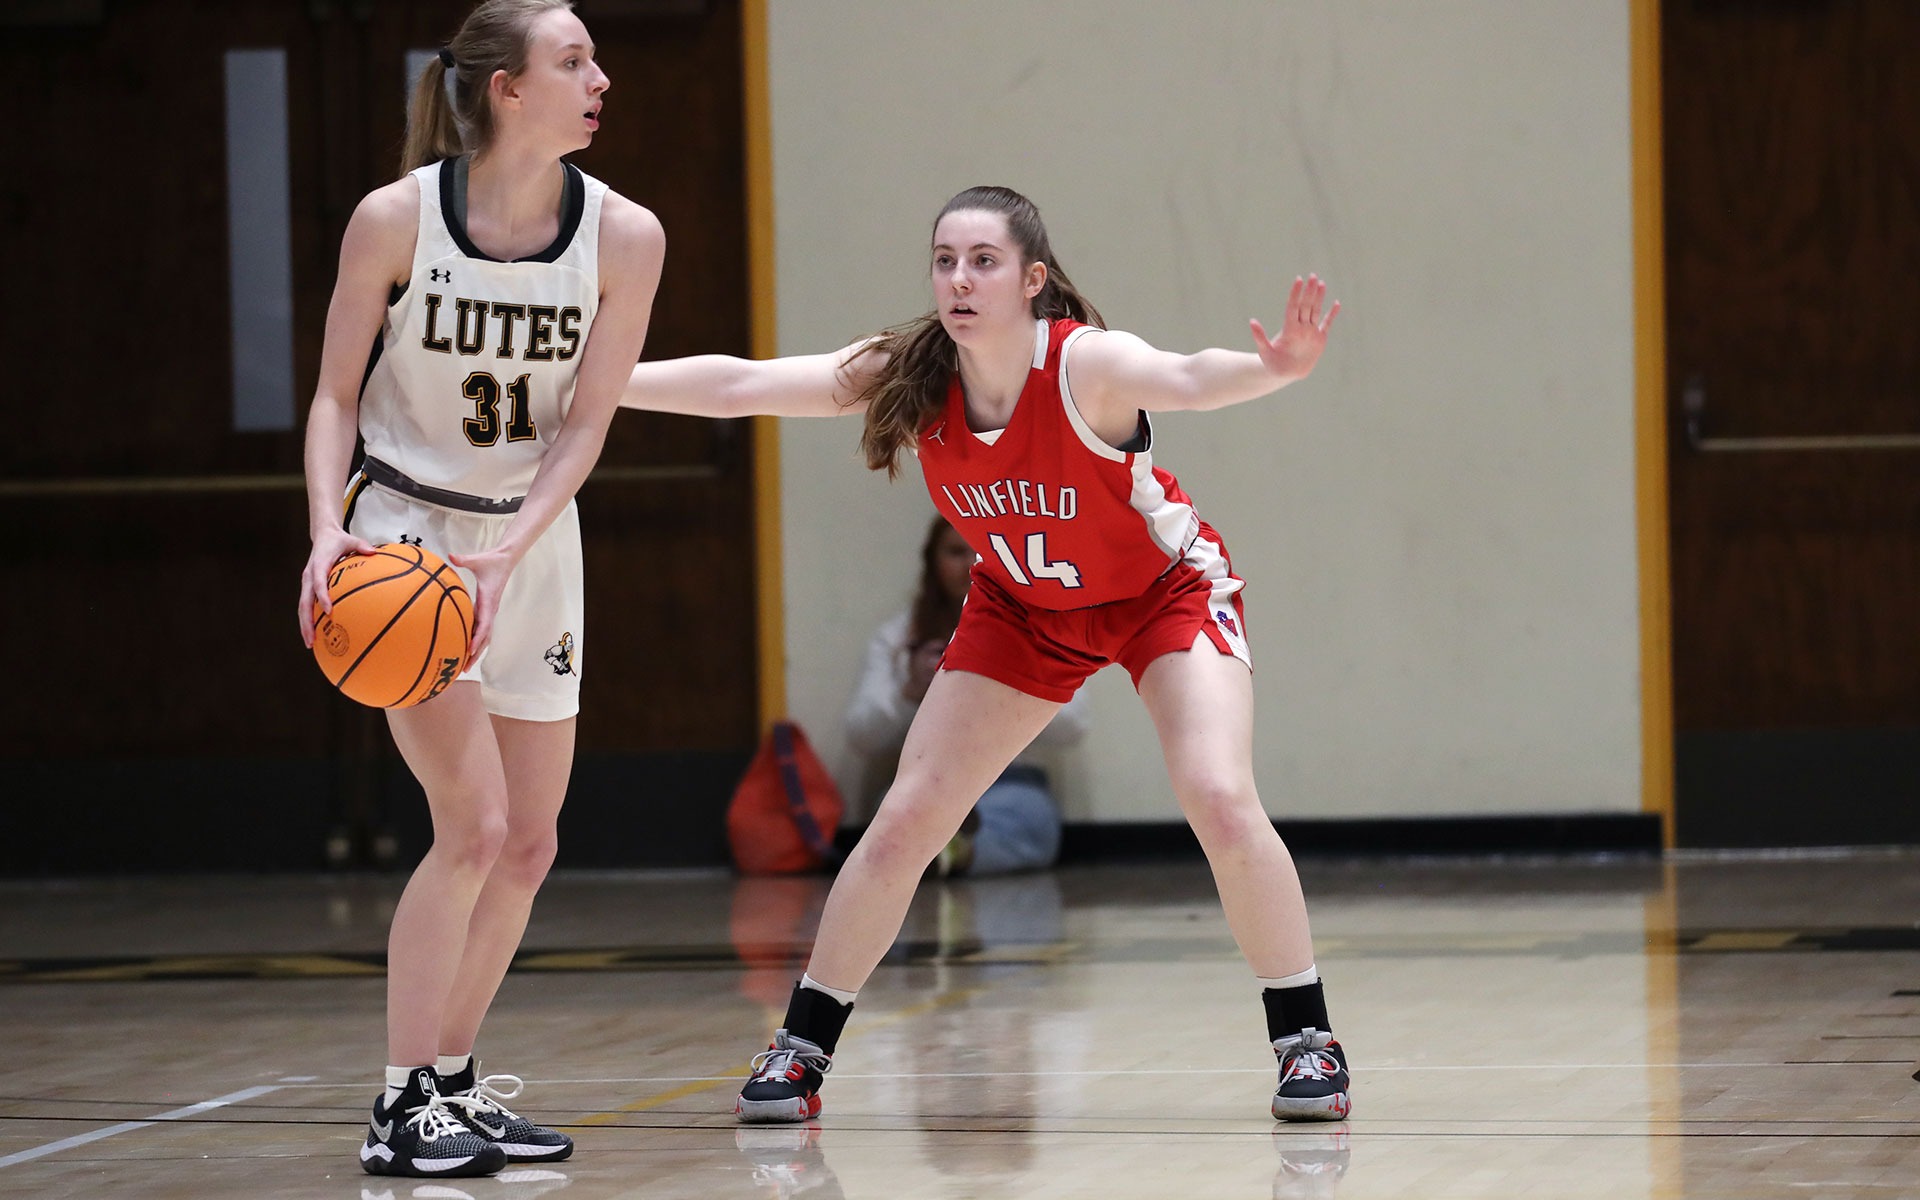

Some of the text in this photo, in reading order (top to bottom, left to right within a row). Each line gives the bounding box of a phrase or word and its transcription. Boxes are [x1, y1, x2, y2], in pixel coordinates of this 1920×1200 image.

[422, 293, 582, 362] LUTES
[462, 371, 537, 447] 31
[941, 479, 1077, 520] LINFIELD
[987, 531, 1084, 589] 14
